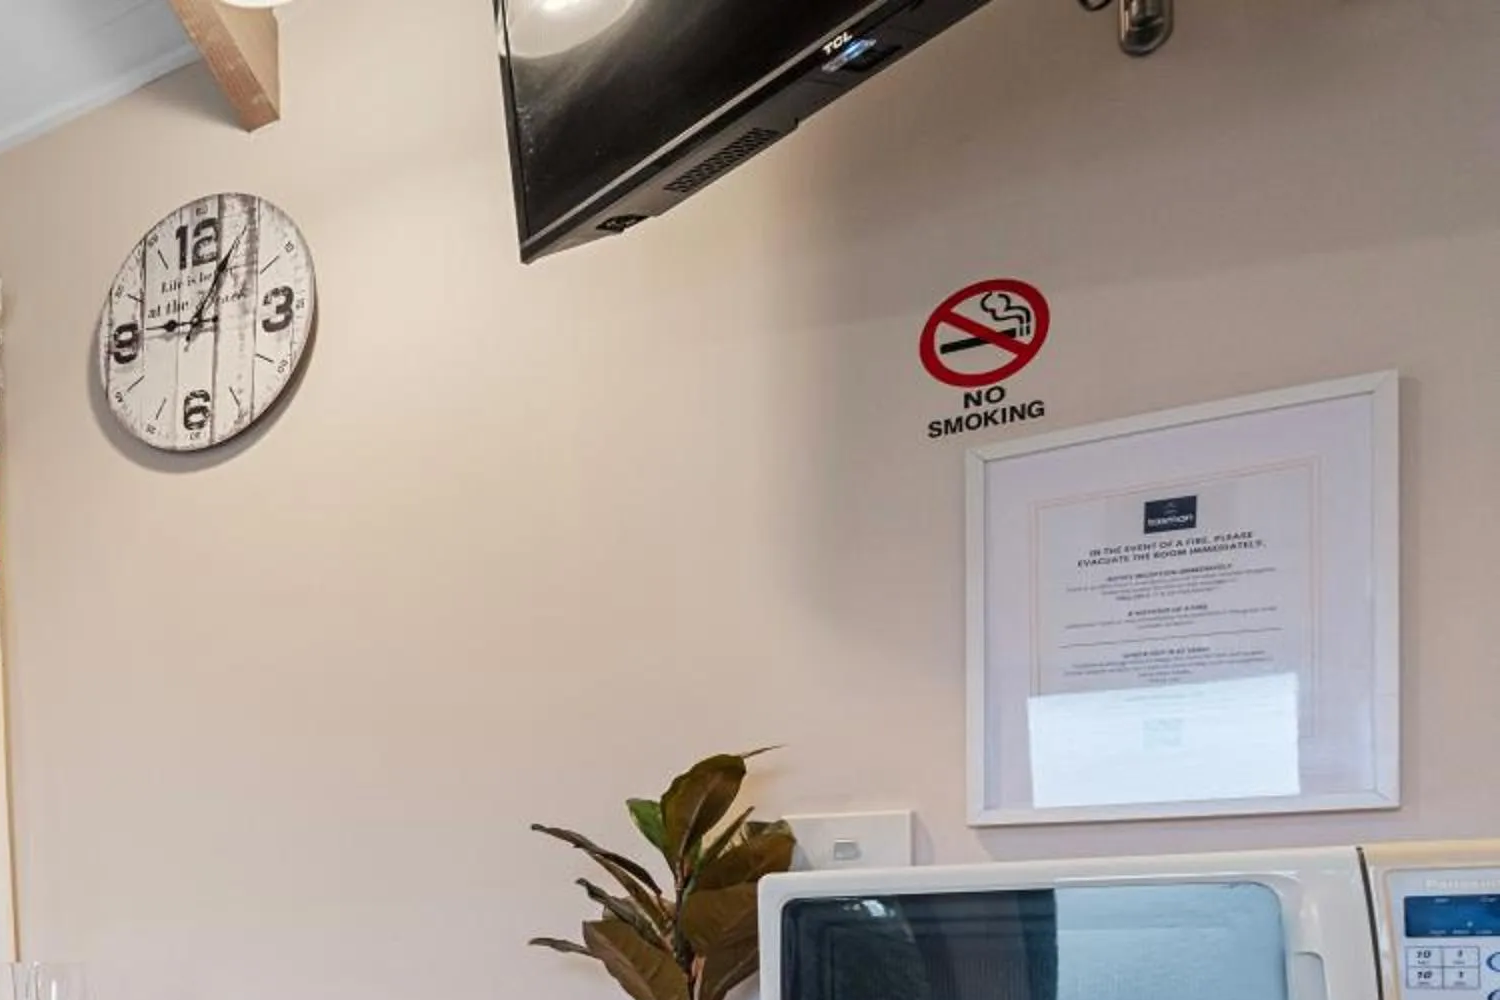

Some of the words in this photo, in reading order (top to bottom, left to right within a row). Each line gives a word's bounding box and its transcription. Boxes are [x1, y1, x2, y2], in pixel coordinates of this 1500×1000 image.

[822, 31, 853, 56] TCL
[176, 217, 221, 270] 12
[262, 285, 295, 332] 3
[113, 322, 139, 365] 9
[183, 389, 210, 430] 6
[964, 386, 1006, 409] NO
[928, 400, 1045, 438] SMOKING
[1213, 531, 1253, 542] PLEASE
